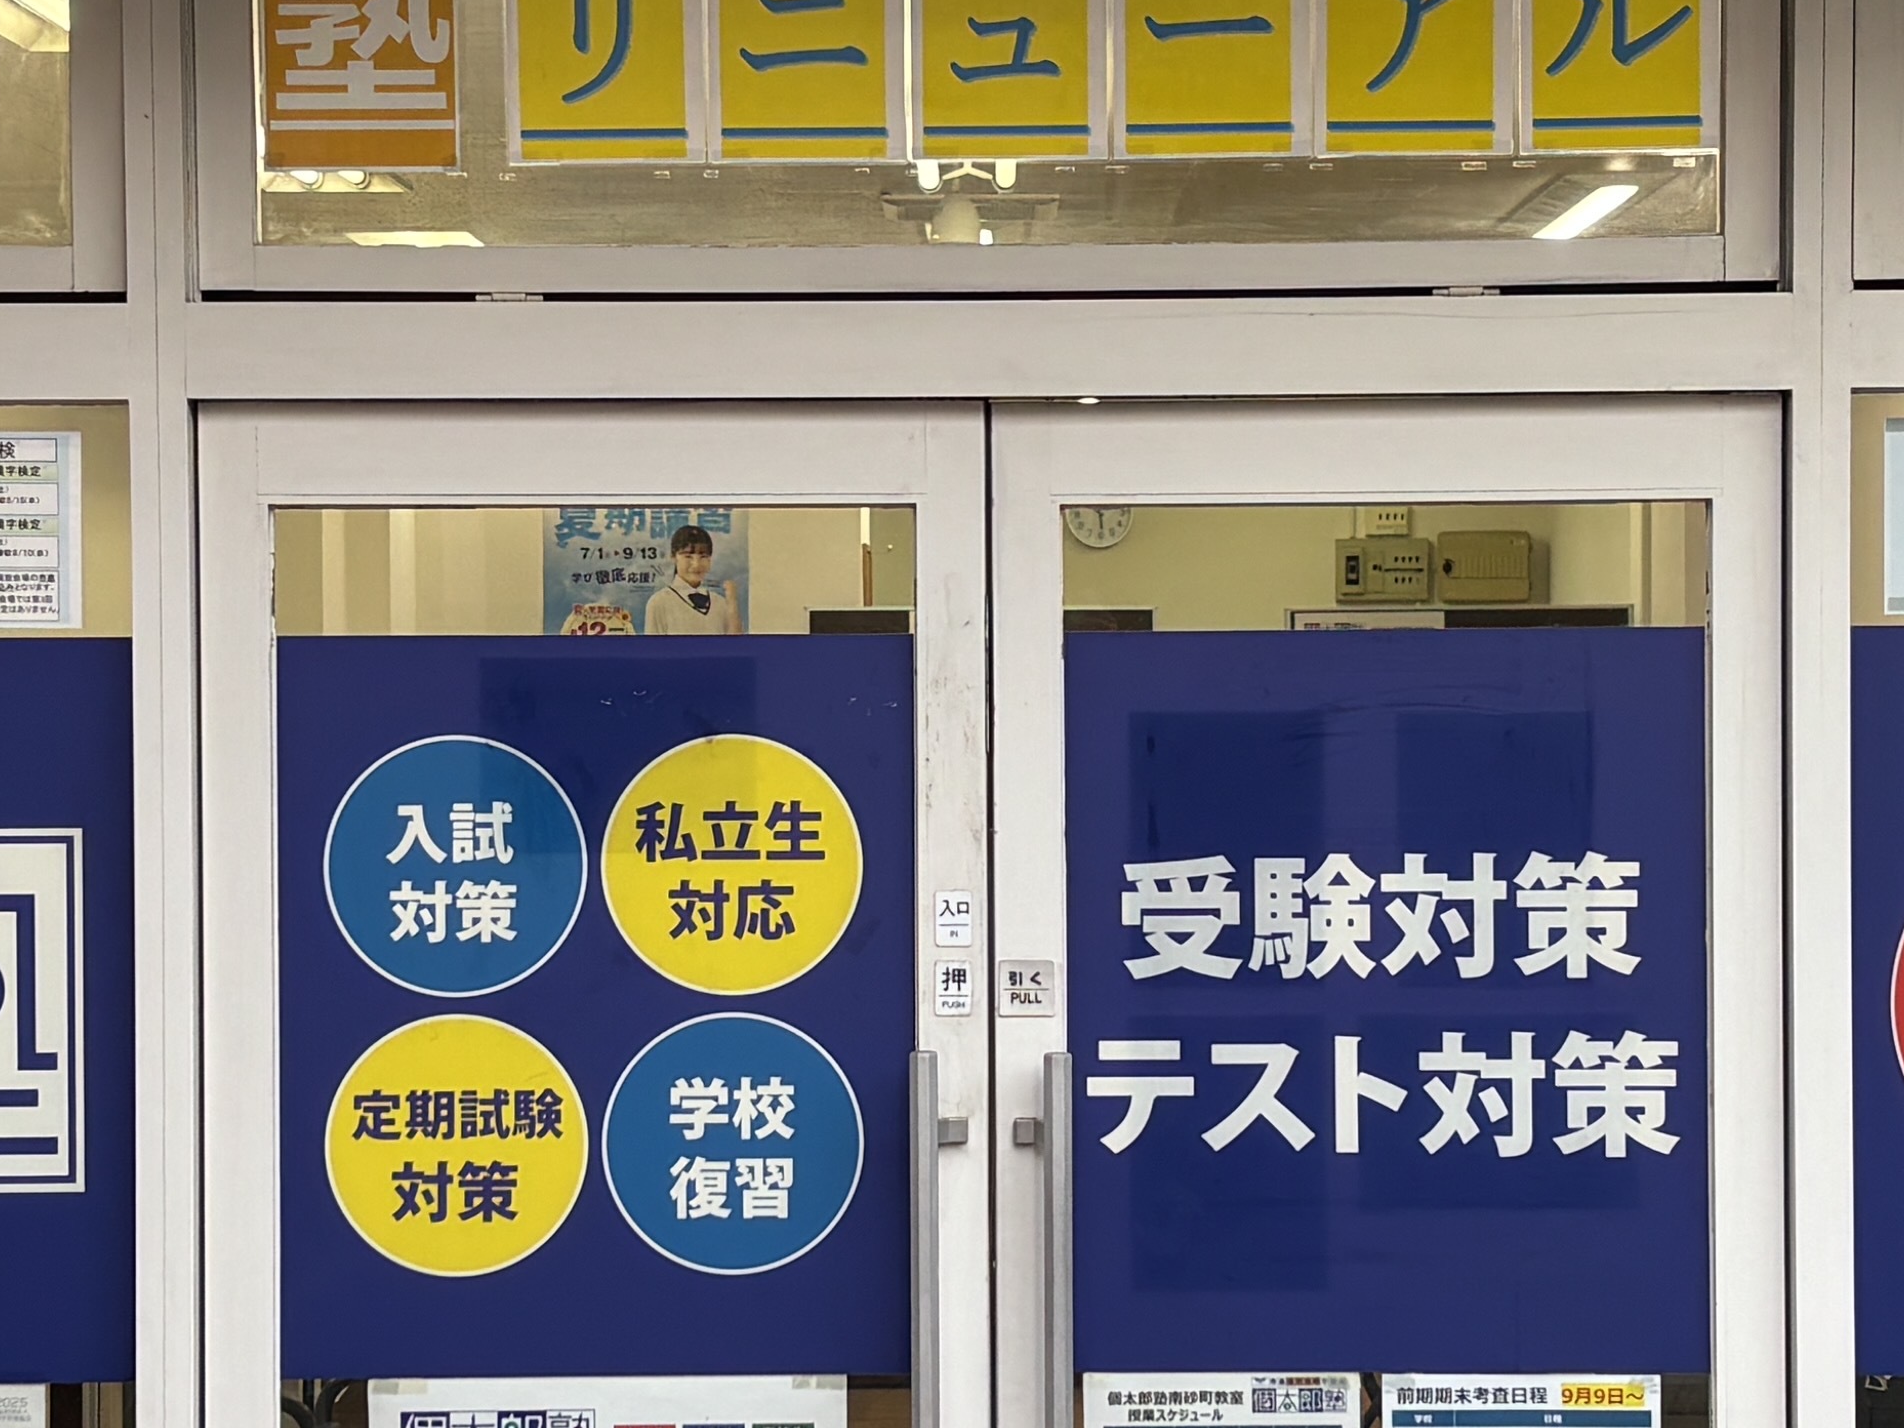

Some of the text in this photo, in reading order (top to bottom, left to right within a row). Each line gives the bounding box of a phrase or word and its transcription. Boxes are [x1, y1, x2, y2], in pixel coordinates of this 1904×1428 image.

[387, 802, 513, 864] 入試
[636, 800, 827, 864] 私立生
[389, 881, 517, 944] 対策
[669, 879, 797, 942] 対応
[939, 900, 969, 917] 入口
[950, 930, 958, 938] IN
[1120, 852, 1642, 981] 受験対策
[941, 967, 966, 991] 押
[942, 1001, 965, 1009] PUSH
[1008, 971, 1042, 986] 引く
[1011, 993, 1042, 1004] PULL
[352, 1089, 564, 1142] 定期試験
[669, 1076, 797, 1142] 学校
[1086, 1032, 1679, 1158] テスト対策
[391, 1161, 520, 1224] 対策
[669, 1156, 797, 1222] 復習
[1396, 1387, 1548, 1405] 前期期末考査日程
